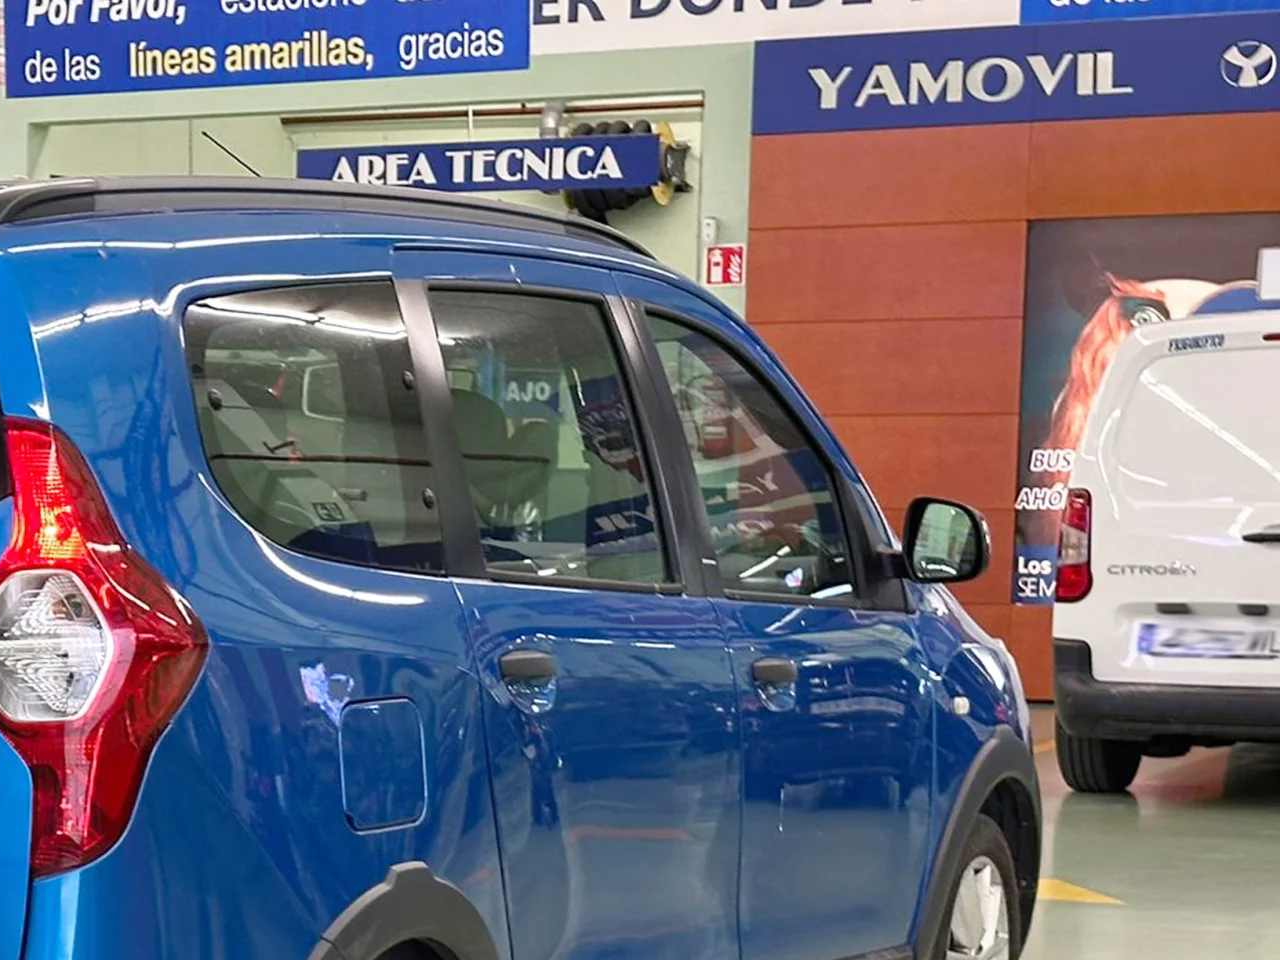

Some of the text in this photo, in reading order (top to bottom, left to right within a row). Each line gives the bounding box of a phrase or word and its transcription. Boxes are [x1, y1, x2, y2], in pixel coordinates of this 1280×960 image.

[25, 0, 83, 26] Por
[24, 22, 504, 83] de las líneas amarillas, gracias
[808, 51, 1134, 110] YAMOVIL
[331, 145, 623, 185] AREA TECNICA
[1018, 556, 1052, 575] Los
